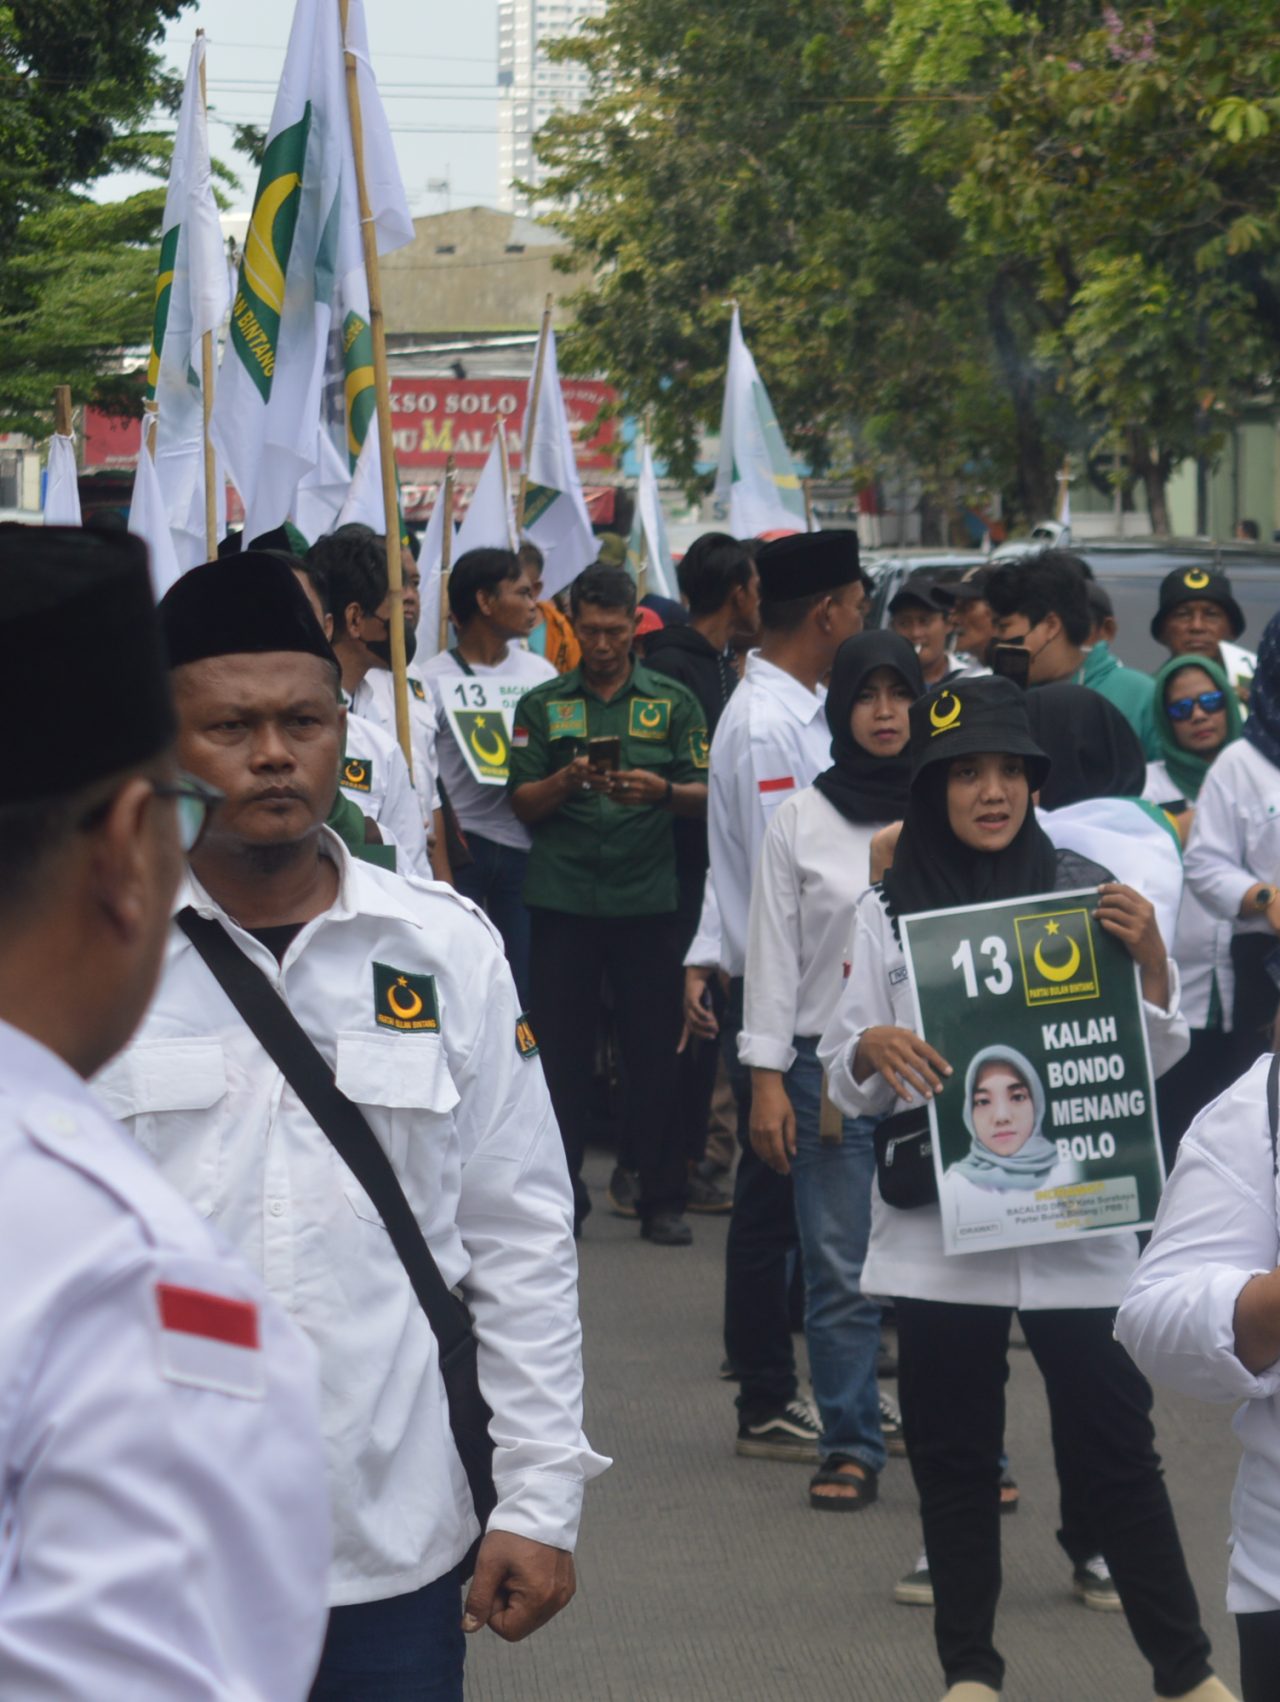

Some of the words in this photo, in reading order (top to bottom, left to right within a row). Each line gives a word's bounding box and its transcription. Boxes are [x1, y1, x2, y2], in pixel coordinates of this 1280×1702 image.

[388, 392, 438, 414] KSO
[444, 392, 517, 415] SOLO
[454, 683, 487, 707] 13
[952, 936, 1013, 998] 13
[1042, 1016, 1117, 1051] KALAH
[1047, 1054, 1125, 1089] BONDO
[1052, 1090, 1146, 1127] MENANG
[1056, 1132, 1116, 1162] BOLO
